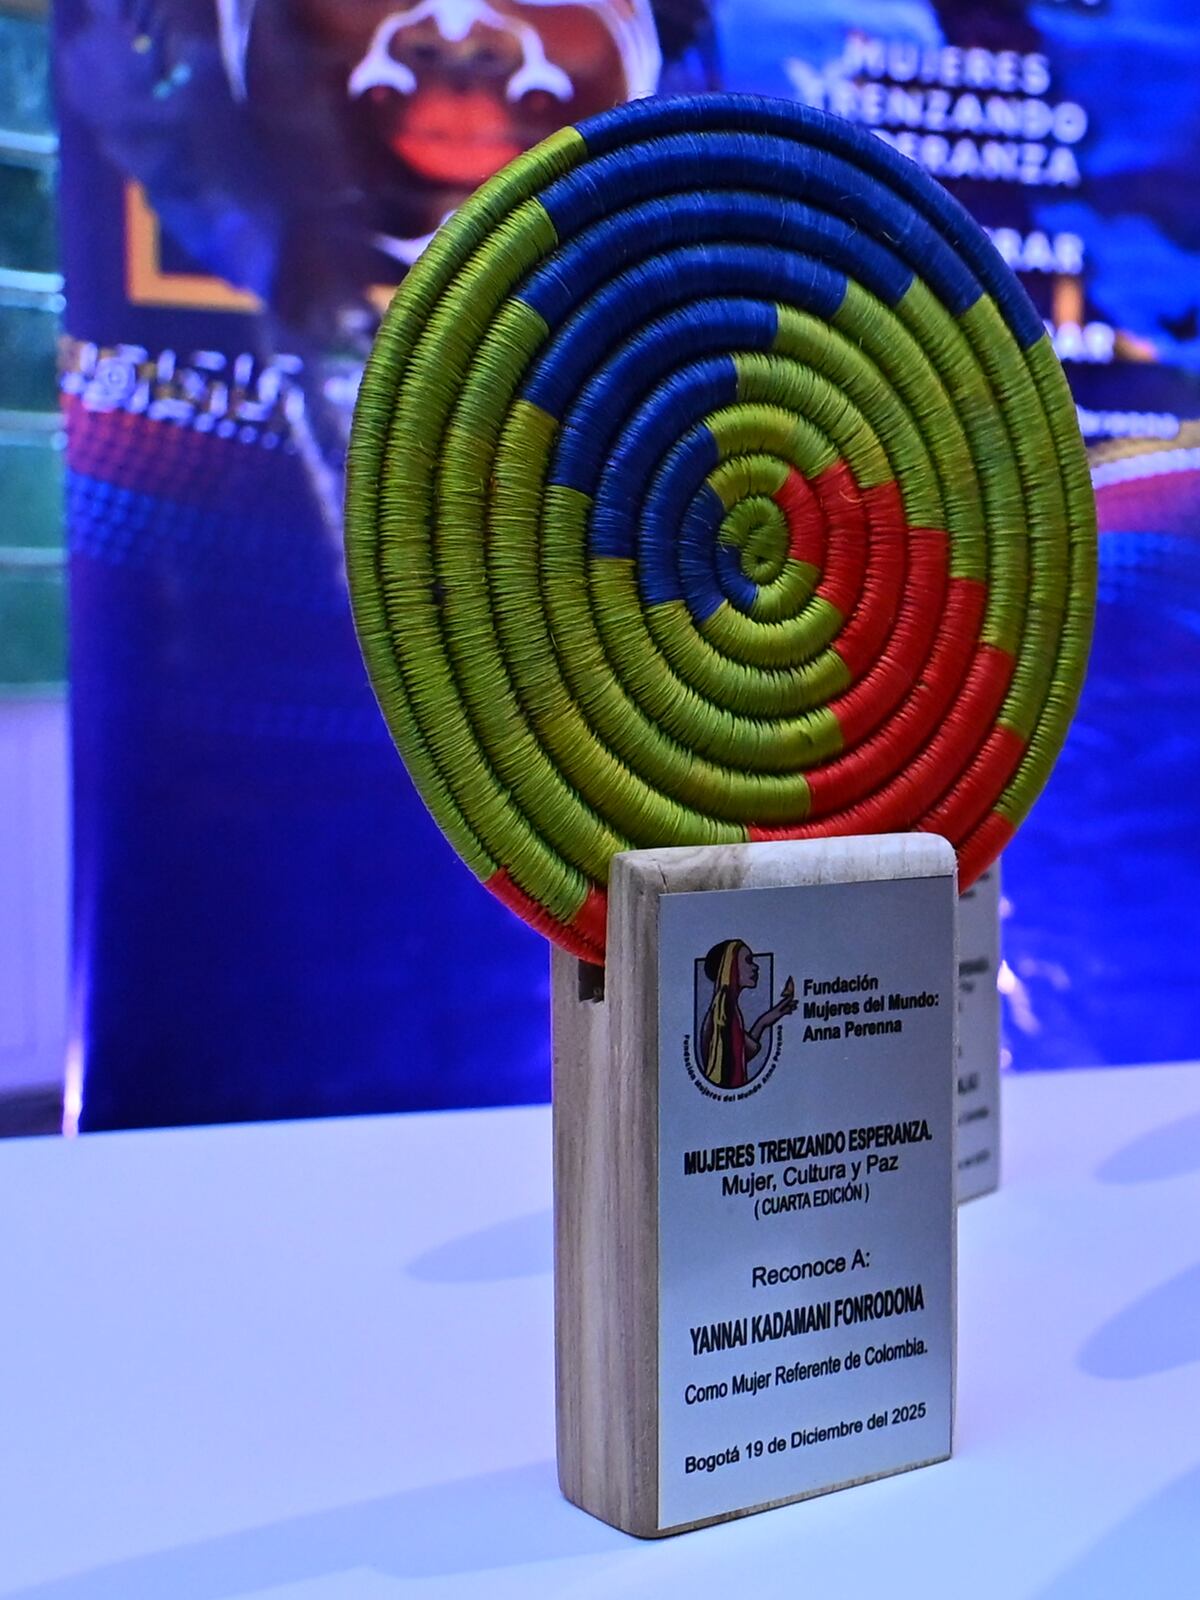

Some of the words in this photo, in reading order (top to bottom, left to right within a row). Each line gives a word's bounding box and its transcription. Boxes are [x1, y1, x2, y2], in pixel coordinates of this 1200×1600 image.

[803, 974, 879, 996] Fundación
[803, 1000, 860, 1021] Mujeres
[863, 995, 885, 1013] del
[888, 991, 939, 1010] Mundo:
[802, 1025, 841, 1043] Anna
[844, 1019, 902, 1038] Perenna
[684, 1142, 755, 1175] MUJERES
[758, 1131, 846, 1164] TRENZANDO
[849, 1120, 933, 1152] ESPERANZA.
[722, 1173, 777, 1198] Mujer,
[783, 1164, 846, 1187] Cultura
[851, 1161, 862, 1181] y
[866, 1154, 899, 1174] Paz
[752, 1256, 846, 1288] Reconoce
[851, 1249, 870, 1270] A:
[690, 1318, 748, 1356] YANNAI
[751, 1301, 831, 1344] KADAMANI
[834, 1284, 925, 1327] FONRODONA
[685, 1381, 728, 1405] Como
[732, 1372, 771, 1396] Mujer
[775, 1358, 841, 1386] Referente
[844, 1351, 861, 1371] de
[864, 1337, 928, 1366] Colombia.
[685, 1445, 740, 1474] Bogotá
[746, 1440, 763, 1459] 19
[767, 1436, 787, 1454] de
[791, 1419, 863, 1449] Diciembre
[867, 1411, 888, 1431] del
[892, 1402, 926, 1424] 2025
